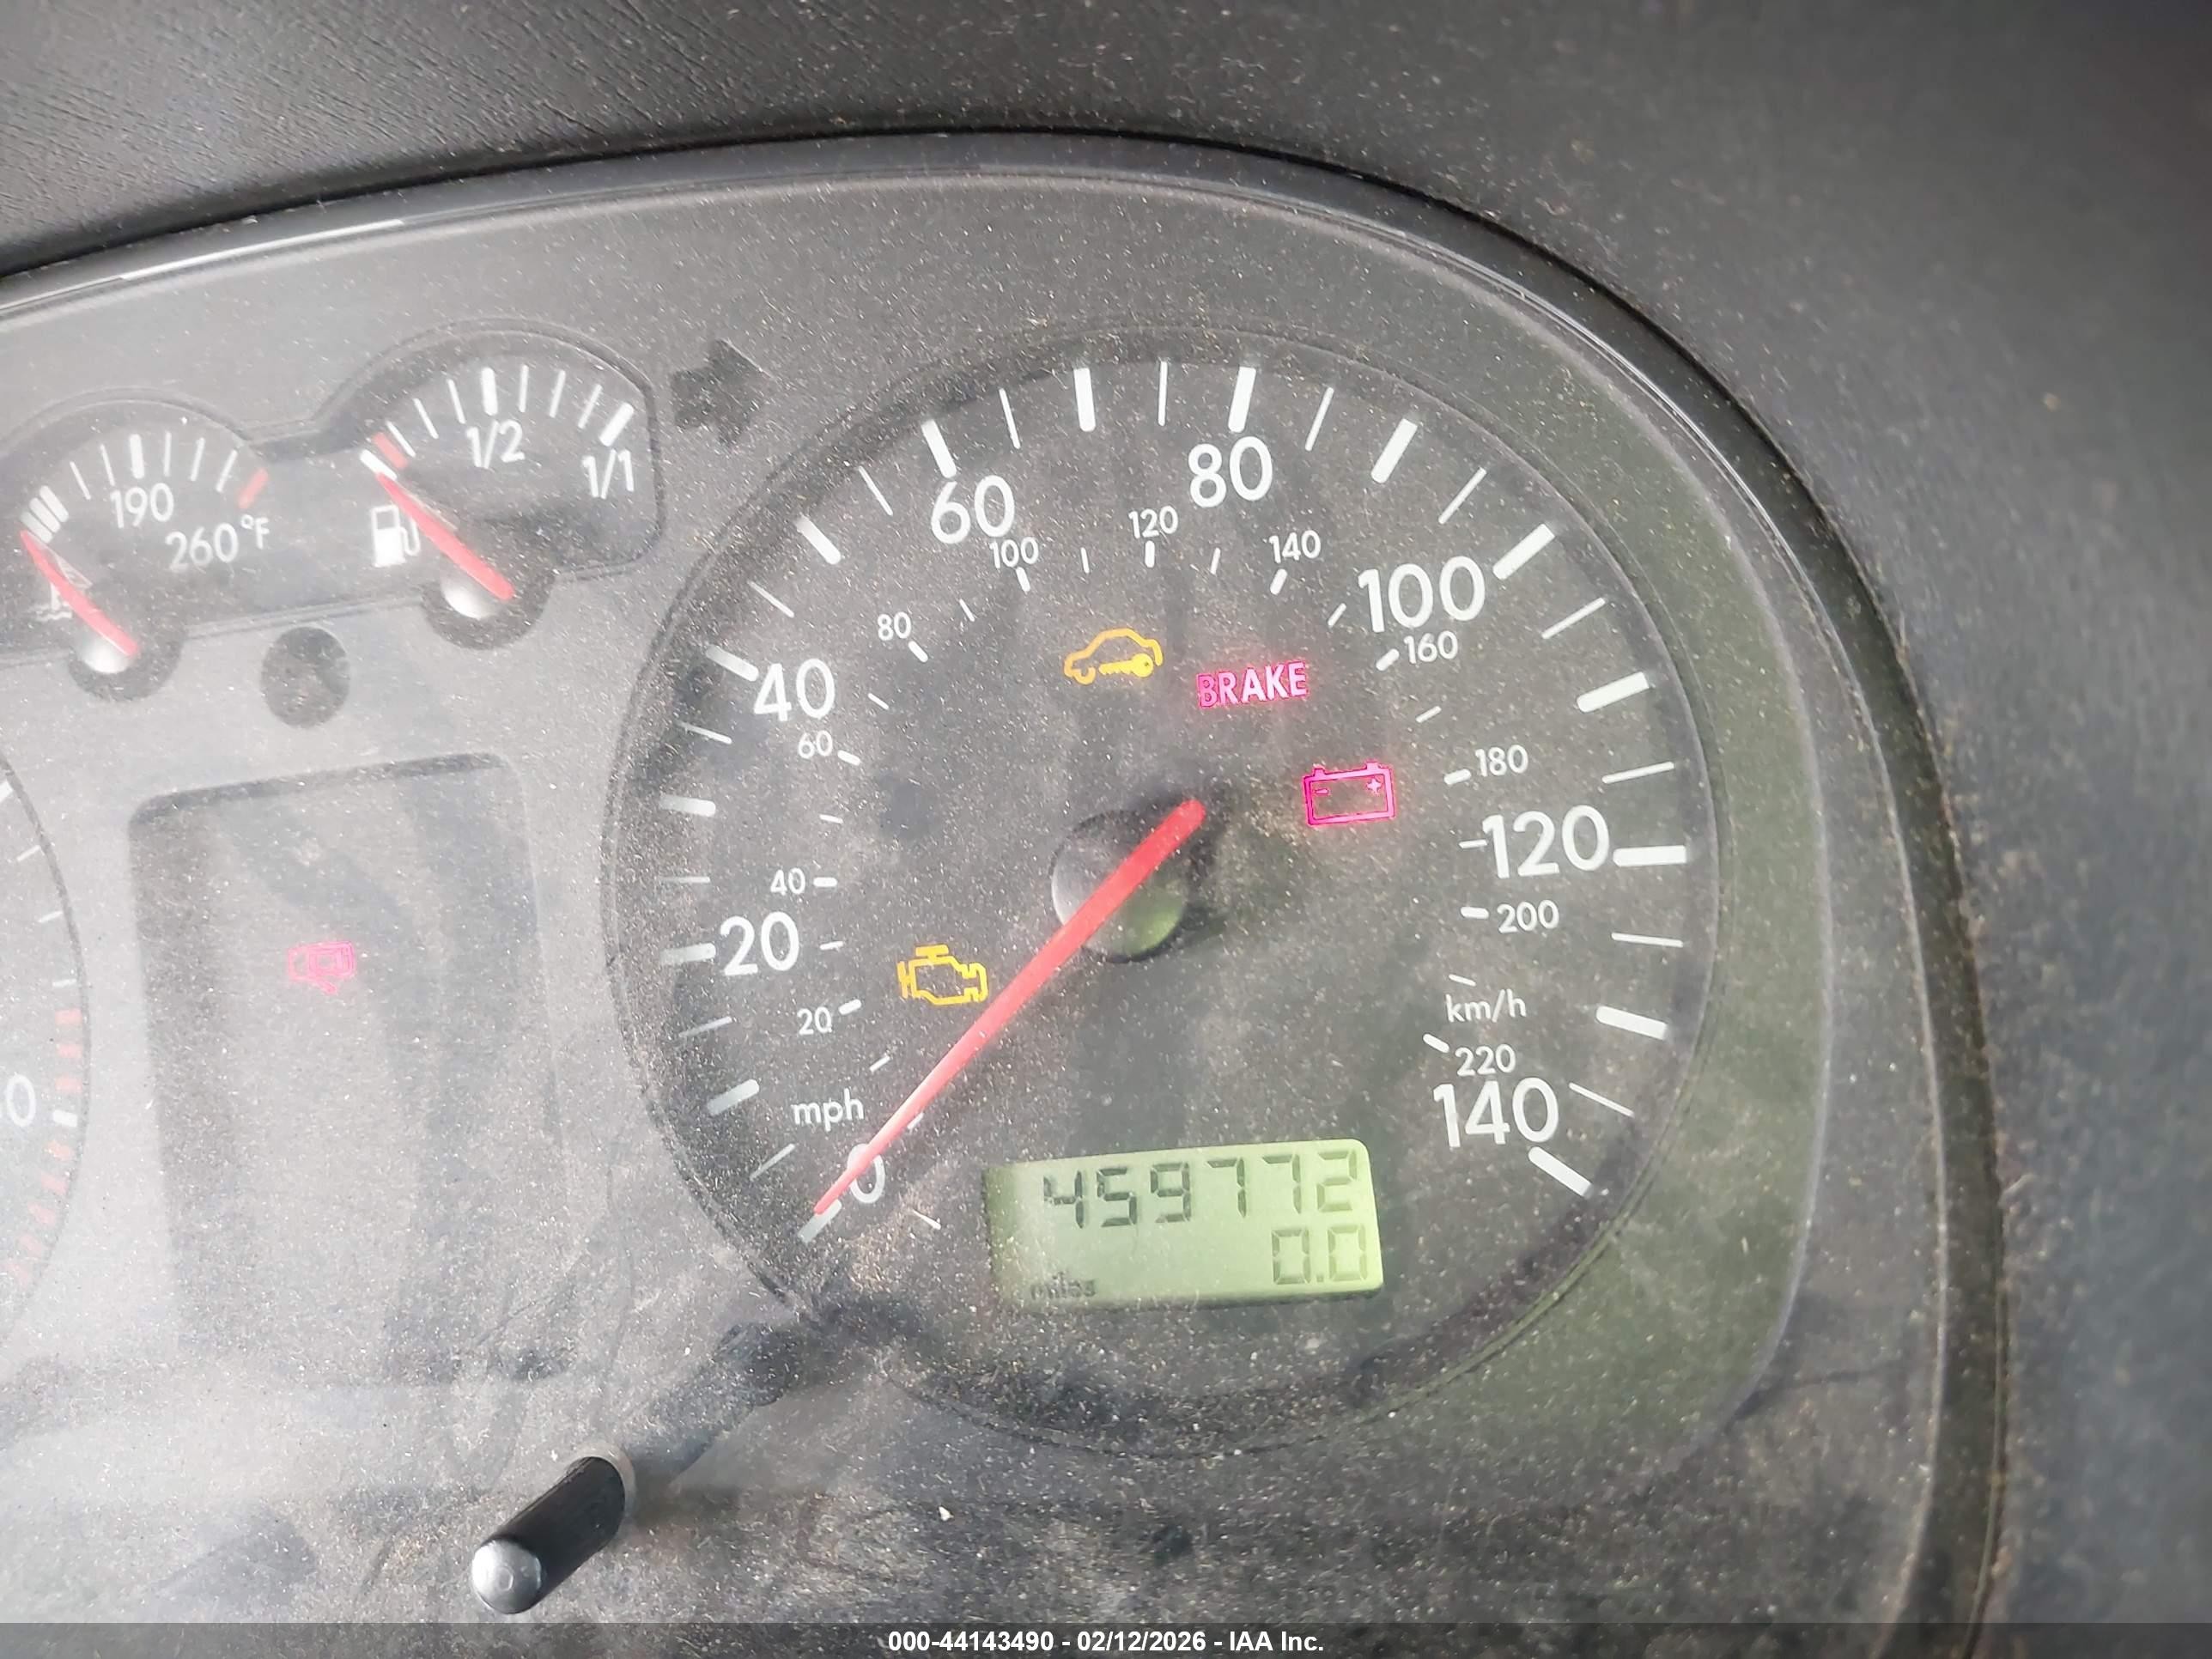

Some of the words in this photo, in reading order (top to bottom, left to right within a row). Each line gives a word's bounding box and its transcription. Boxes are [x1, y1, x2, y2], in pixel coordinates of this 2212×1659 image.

[466, 421, 526, 468] 1/2
[582, 448, 634, 499] 1/1
[1188, 435, 1273, 507] 80
[110, 483, 174, 529] 190
[930, 475, 1015, 544] 60
[1128, 505, 1178, 538] 120
[989, 537, 1039, 568] 100
[1269, 530, 1322, 563] 140
[1358, 556, 1486, 633] 100
[877, 611, 912, 641] 80
[1403, 630, 1458, 665] 160
[753, 658, 836, 722] 40
[1196, 661, 1307, 708] BRAKE
[798, 730, 833, 759] 60
[1474, 744, 1528, 775] 180
[1481, 805, 1610, 878] 120
[770, 867, 805, 896] 40
[1497, 899, 1559, 933] 200
[720, 911, 799, 976] 20
[797, 1006, 833, 1036] 20
[1445, 988, 1527, 1024] km/h
[1455, 1044, 1516, 1076] 220
[793, 1088, 864, 1132] mph
[1432, 1077, 1559, 1148] 140
[847, 1143, 885, 1203] 0
[1043, 1149, 1358, 1230] 459772
[1271, 1224, 1368, 1285] 0.0
